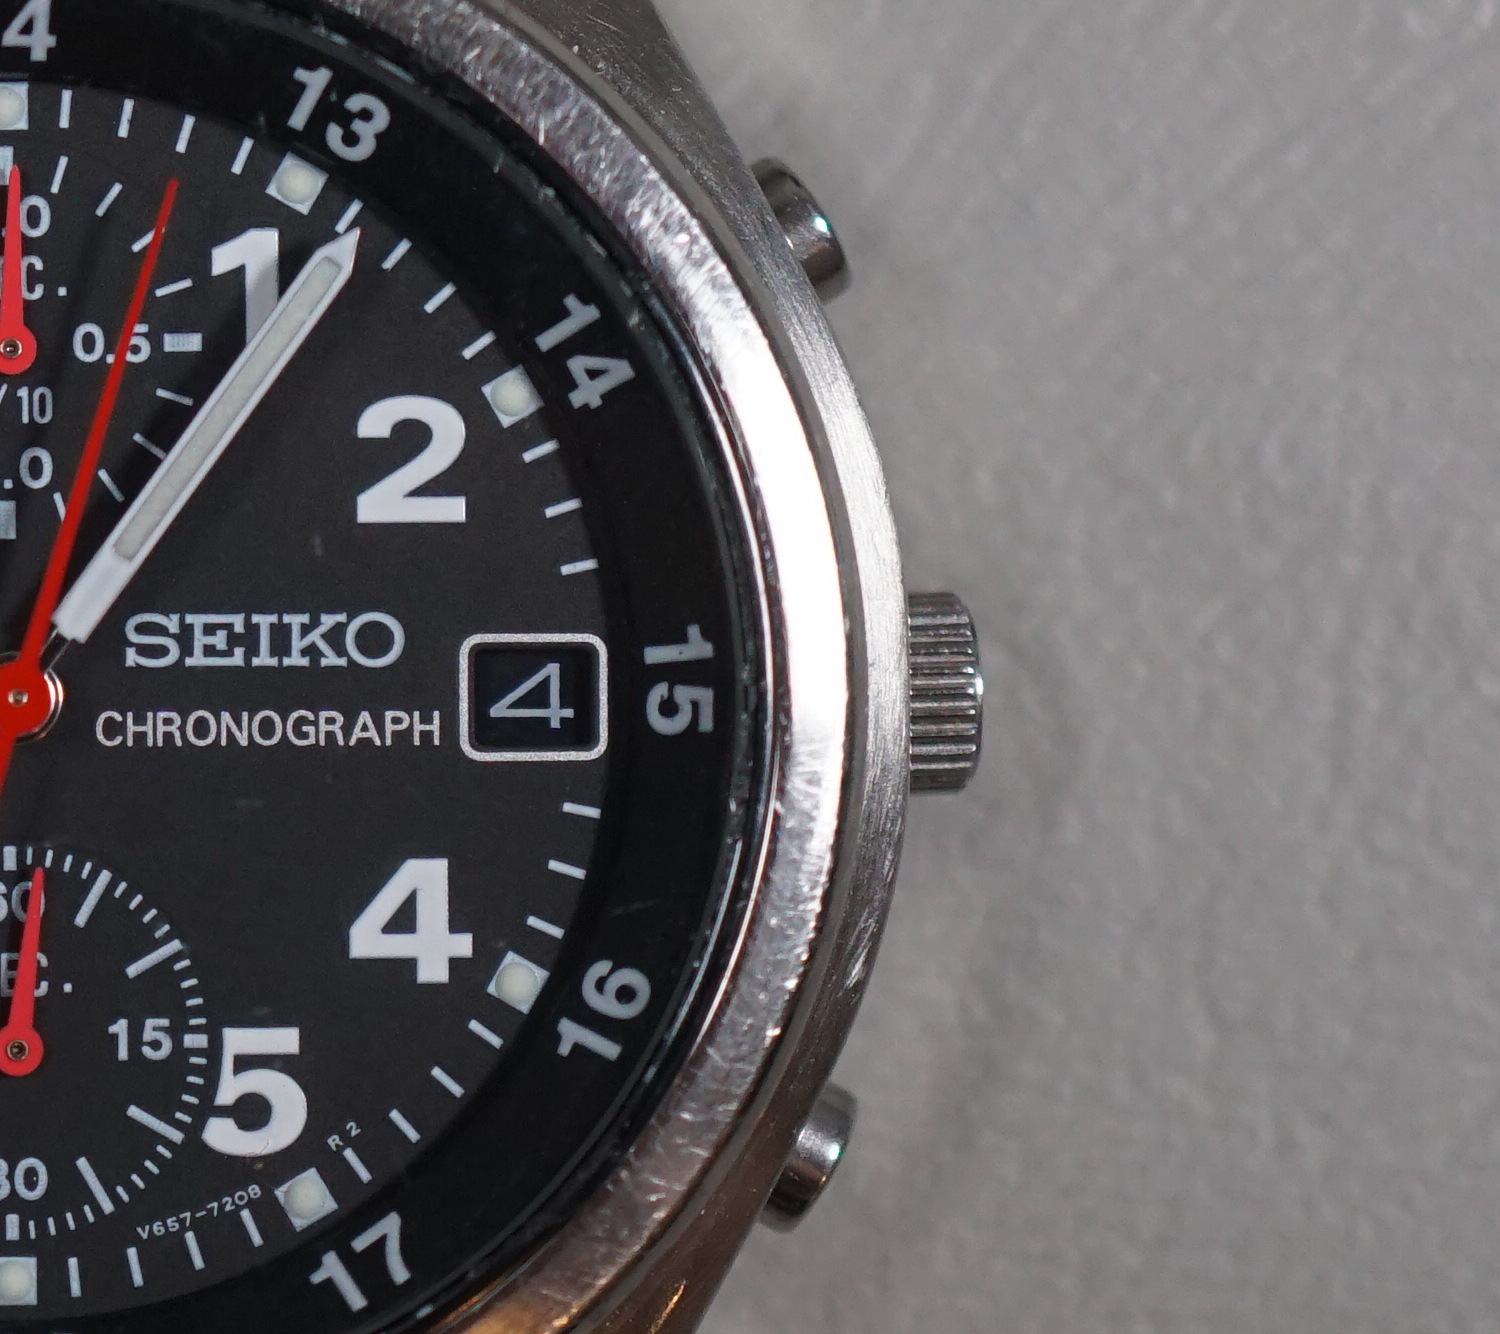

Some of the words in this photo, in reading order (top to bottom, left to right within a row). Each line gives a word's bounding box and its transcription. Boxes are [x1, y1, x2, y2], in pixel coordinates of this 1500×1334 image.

[286, 67, 392, 161] 13
[72, 322, 151, 364] 0.5
[535, 293, 637, 411] 14
[356, 395, 467, 524] 2
[124, 611, 406, 668] SEIKO
[643, 624, 715, 736] 15
[95, 709, 441, 749] CHRONOGRAPH
[489, 663, 575, 729] 4
[348, 857, 473, 985] 4
[107, 1018, 173, 1061] 15
[557, 960, 651, 1061] 16
[201, 1027, 308, 1157] 5
[136, 1183, 262, 1241] V657-7208
[309, 1211, 413, 1312] 17
